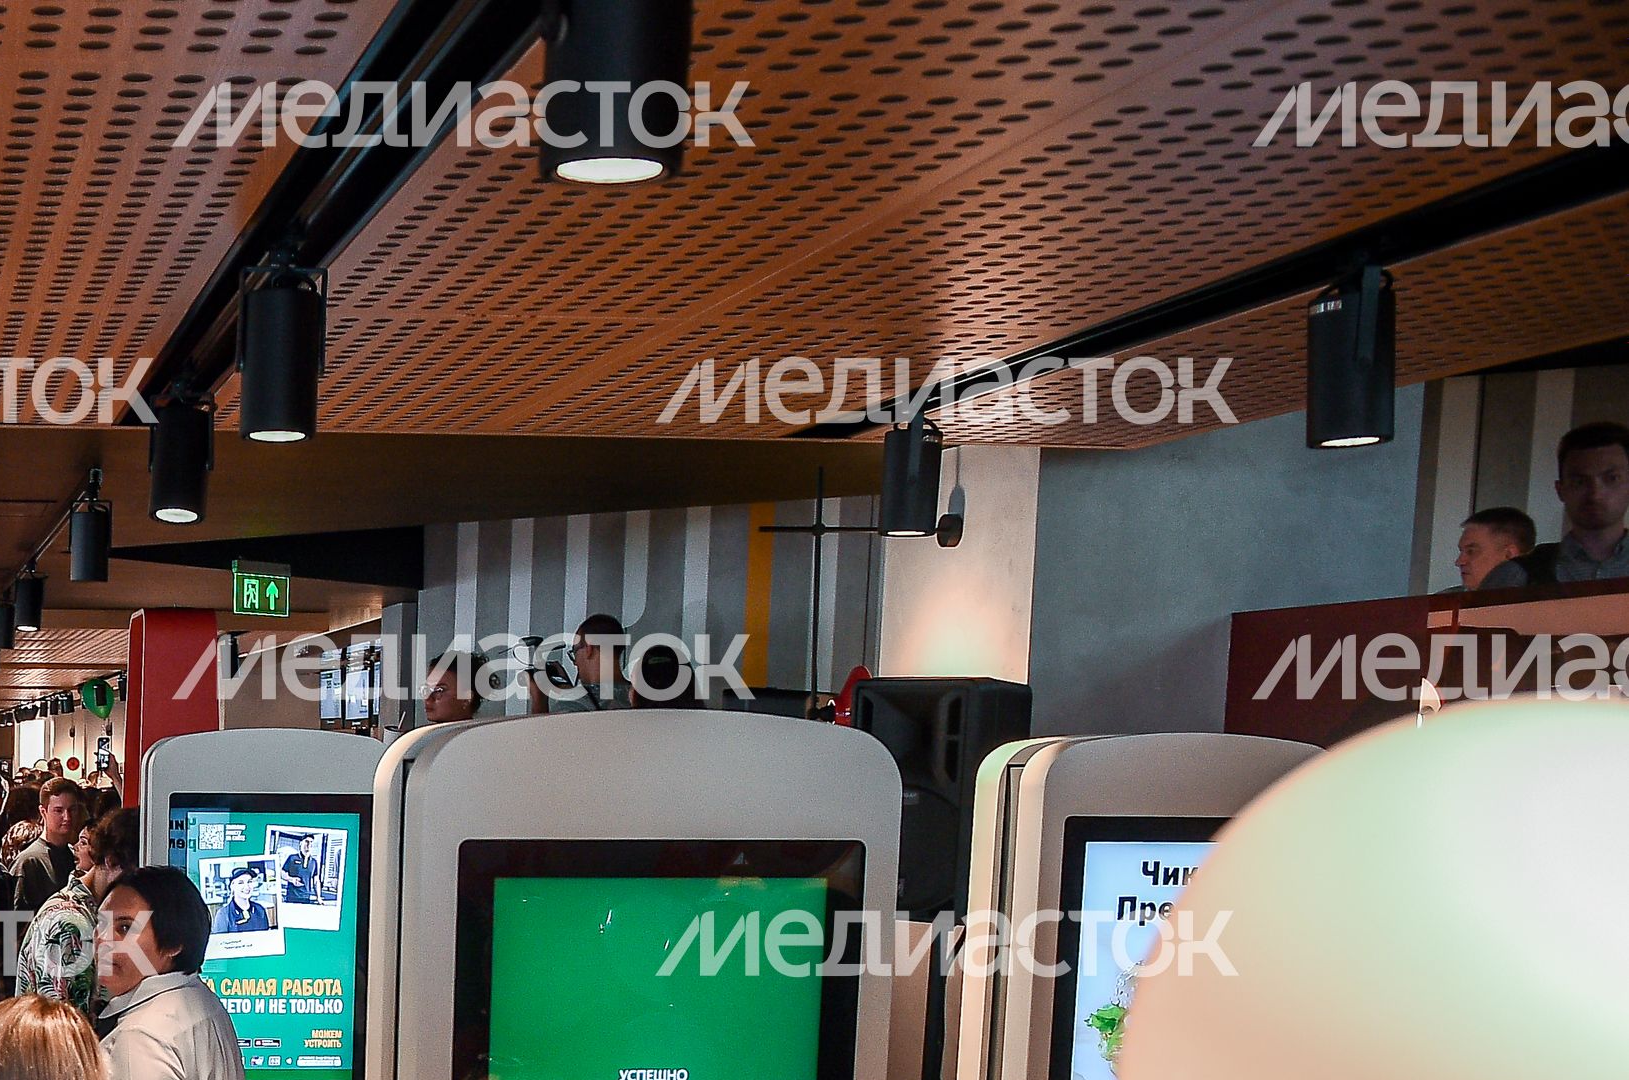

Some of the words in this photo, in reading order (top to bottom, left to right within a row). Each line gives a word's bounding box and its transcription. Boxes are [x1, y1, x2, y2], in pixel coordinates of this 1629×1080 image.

[220, 978, 276, 996] САМАЯ
[282, 978, 343, 996] РАБОТА
[254, 998, 265, 1014] И
[268, 998, 287, 1014] НЕ
[289, 998, 344, 1014] ТОЛЬКО
[311, 1029, 343, 1039] МОЖЕМ
[303, 1039, 342, 1049] УСТРОИТЬ
